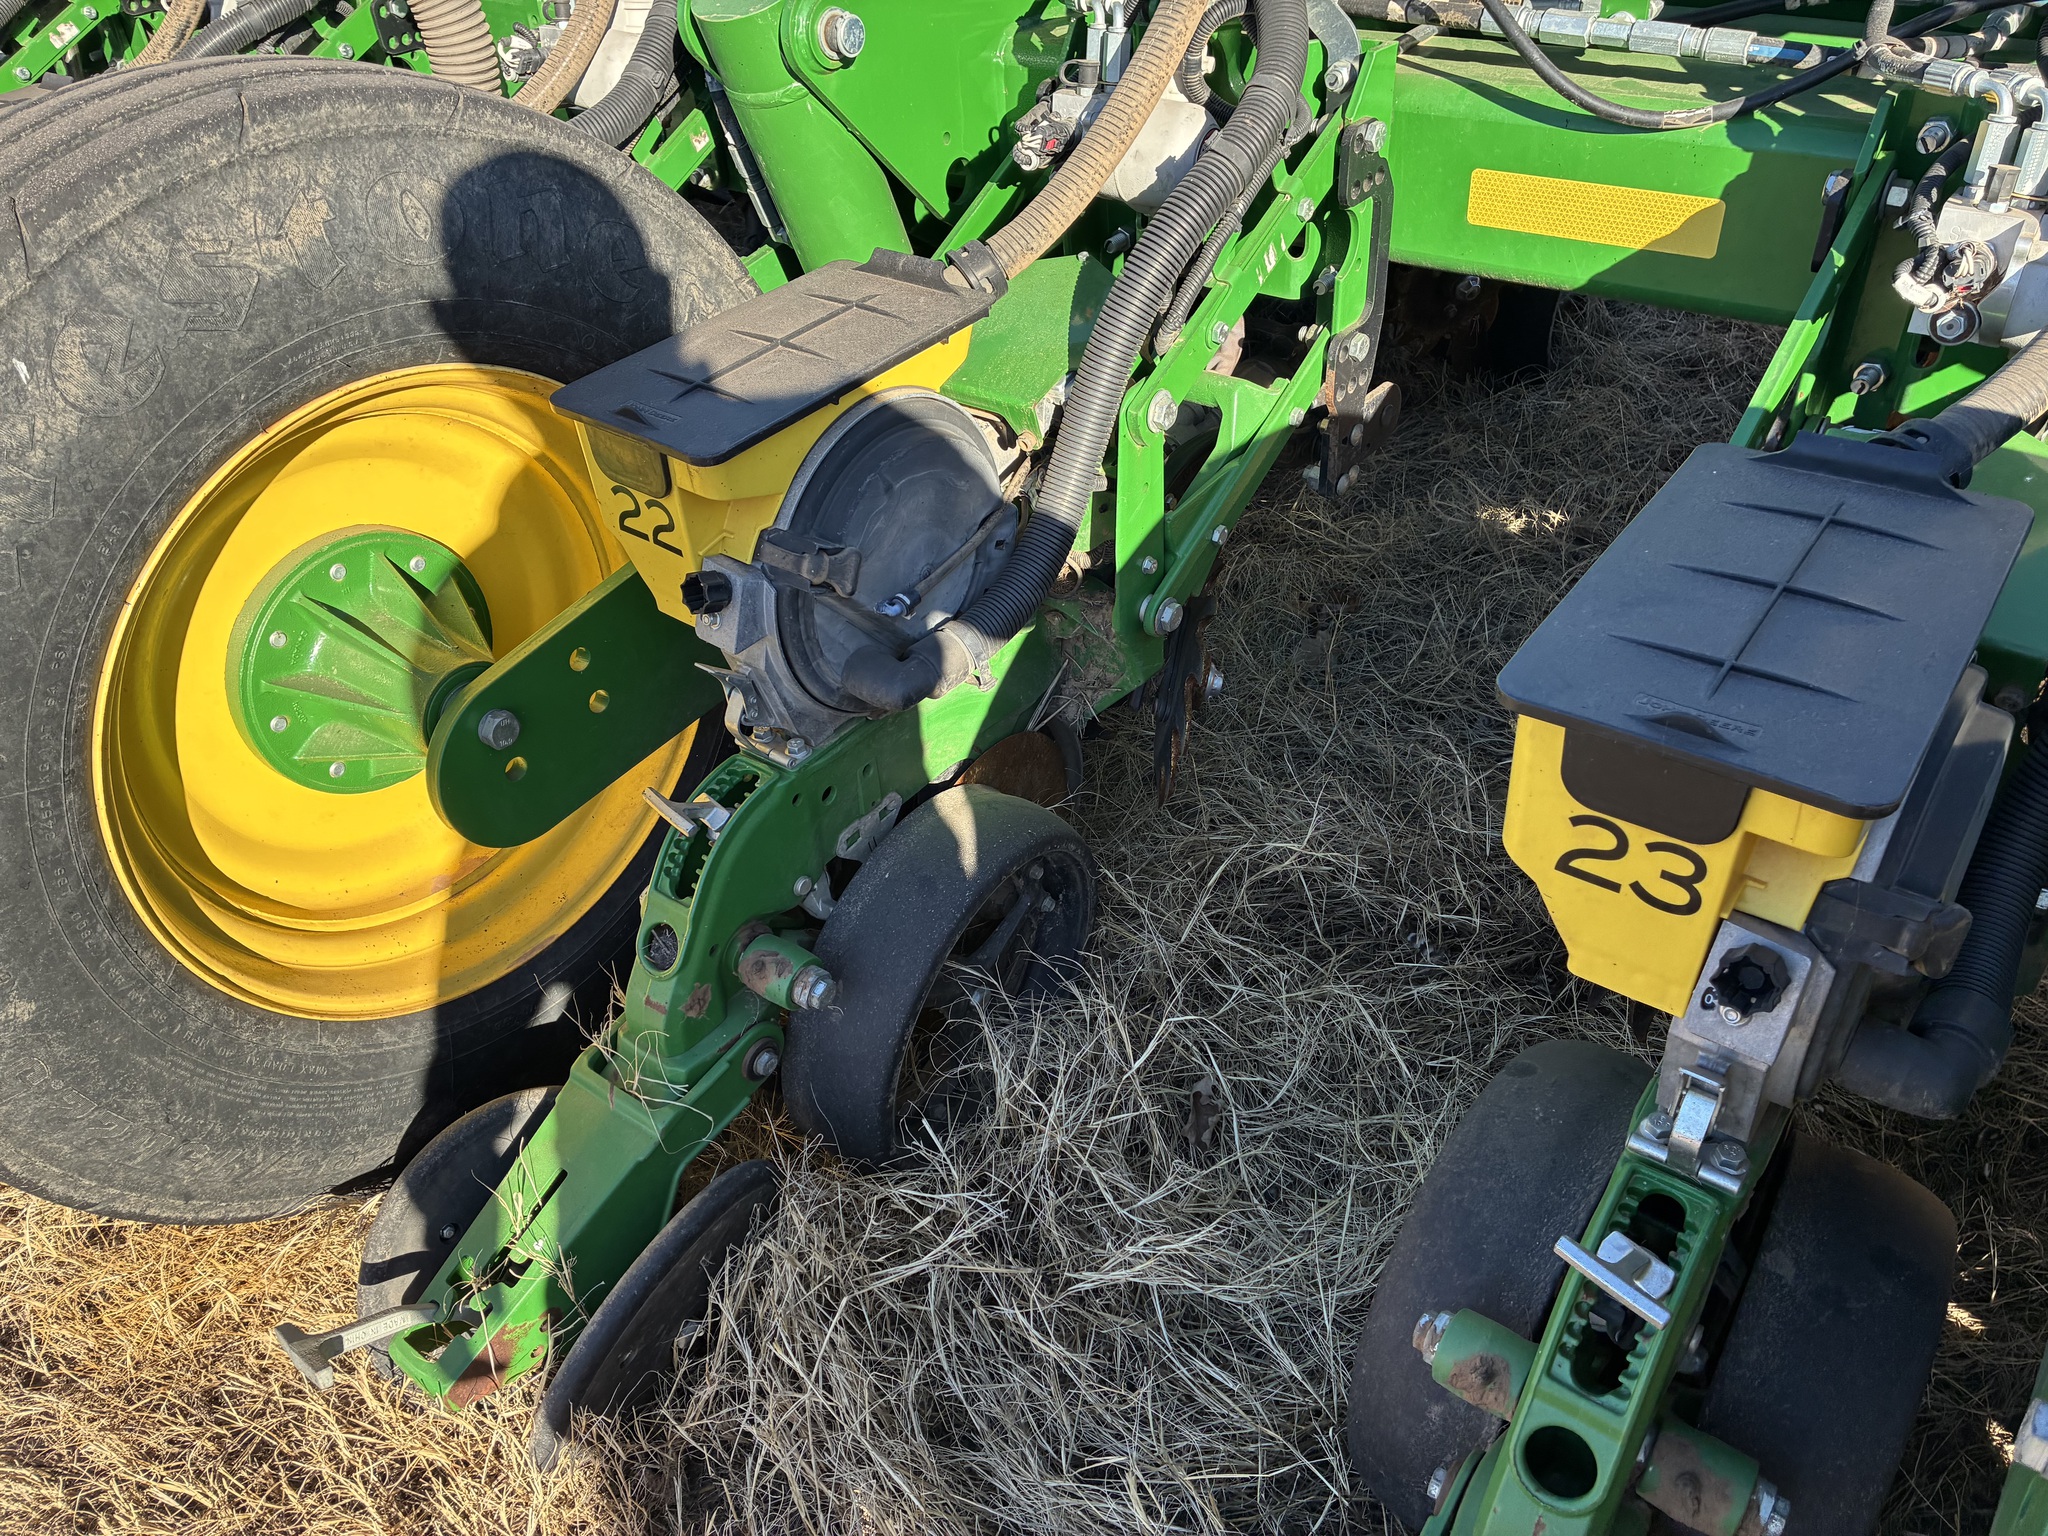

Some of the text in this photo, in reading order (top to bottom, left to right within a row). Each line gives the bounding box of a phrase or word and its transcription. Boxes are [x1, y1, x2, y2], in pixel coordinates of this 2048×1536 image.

[611, 485, 684, 557] 22
[54, 866, 74, 897] LBS
[97, 523, 124, 557] BAR
[1554, 814, 1710, 916] 23
[370, 1326, 380, 1336] IN
[383, 1314, 407, 1330] MADE
